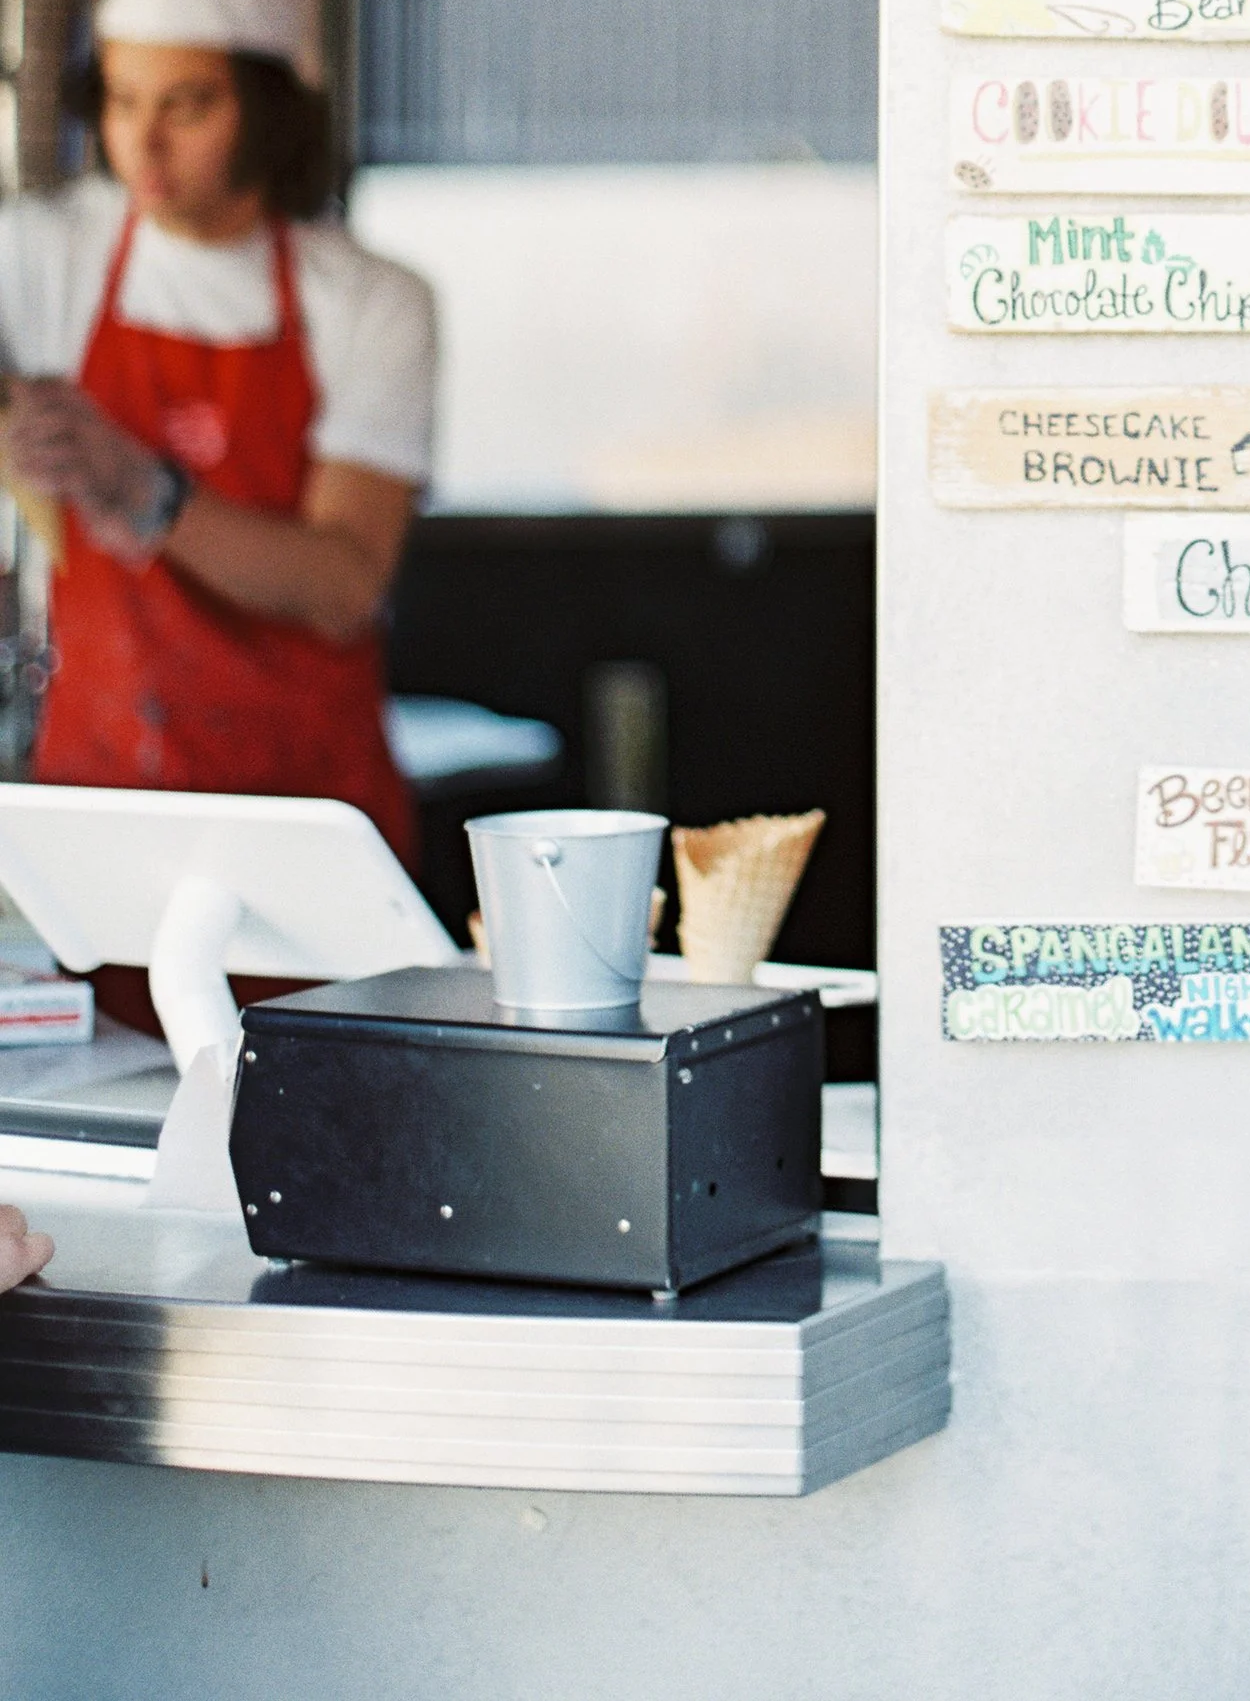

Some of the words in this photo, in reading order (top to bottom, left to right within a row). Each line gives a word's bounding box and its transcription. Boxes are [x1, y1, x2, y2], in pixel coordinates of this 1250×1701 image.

[971, 78, 1158, 146] COOKIE
[1027, 213, 1136, 267] Mint
[972, 266, 1156, 326] Chocolate
[998, 409, 1213, 441] CHEESECAKE
[1022, 449, 1220, 493] BROWNIE
